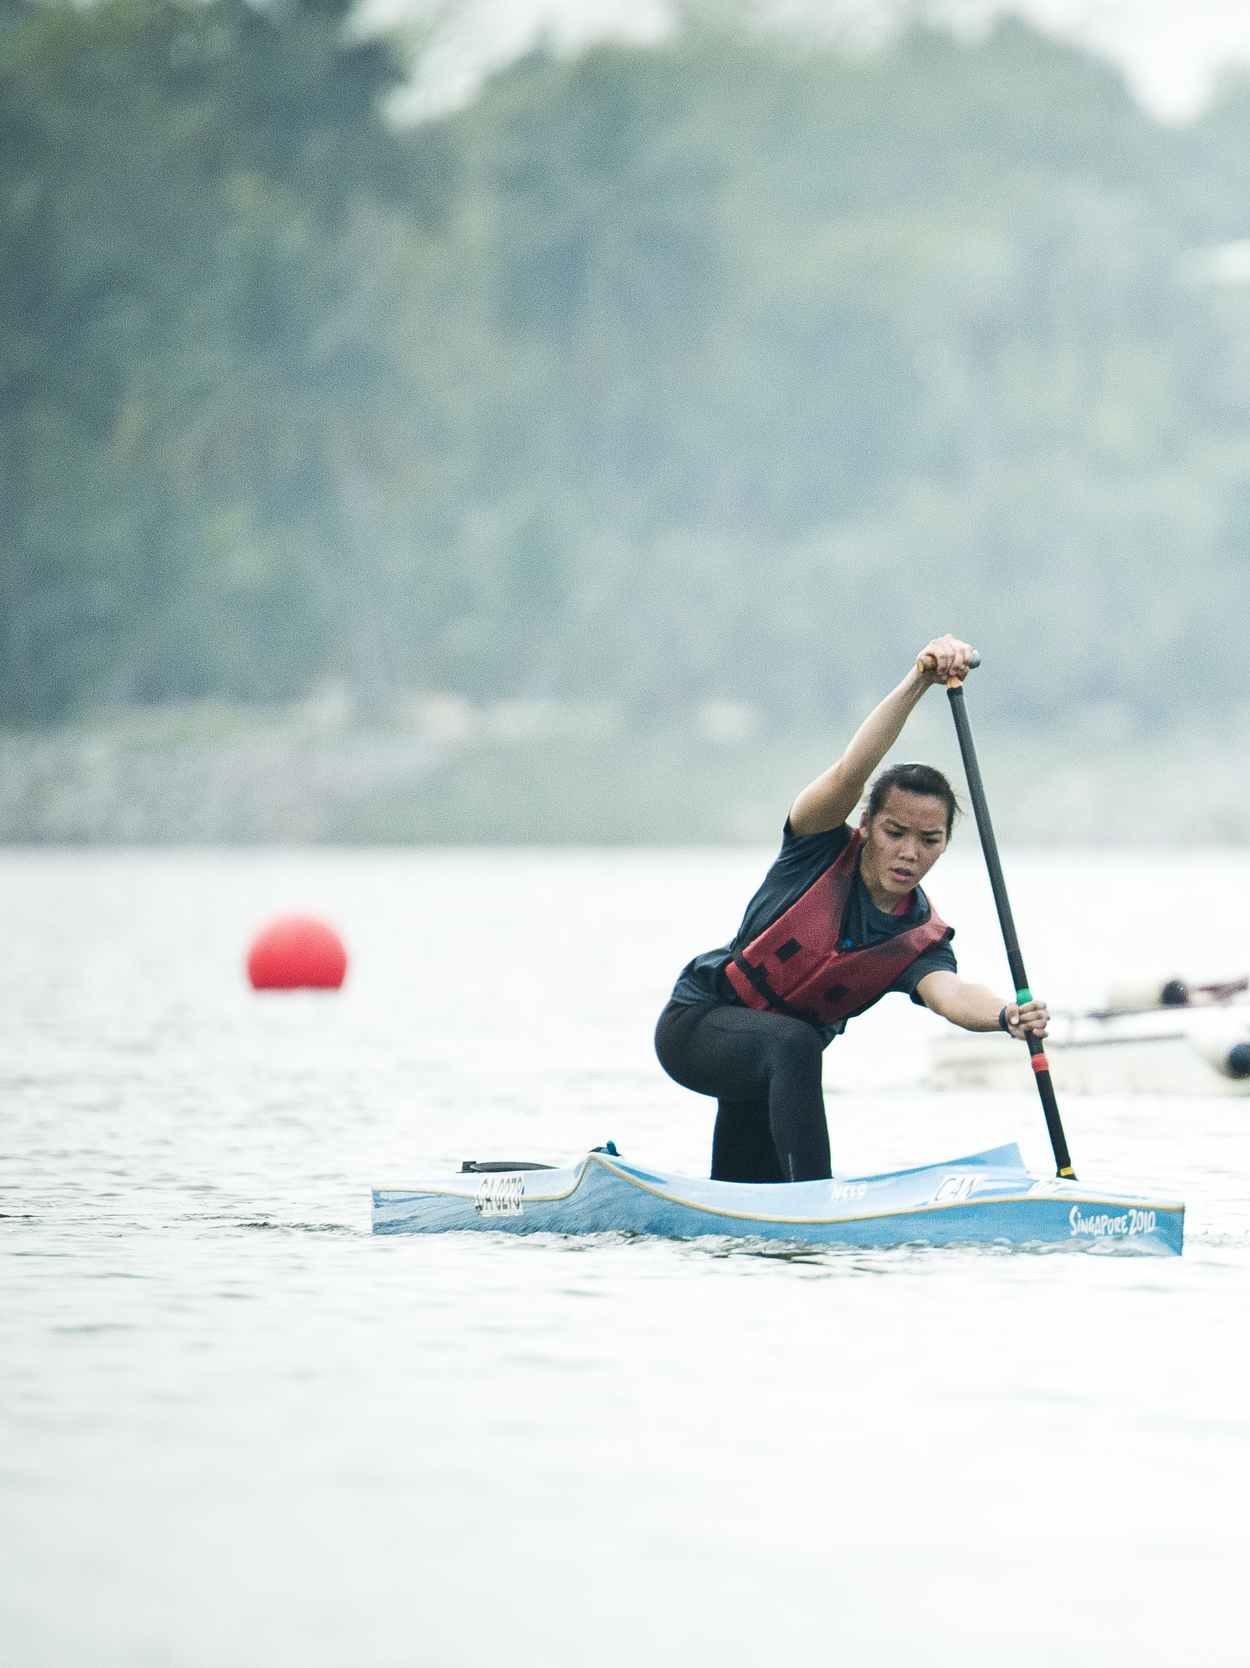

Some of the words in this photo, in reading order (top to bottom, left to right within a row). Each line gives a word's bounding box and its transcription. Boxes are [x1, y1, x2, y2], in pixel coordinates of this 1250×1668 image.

[830, 1183, 867, 1199] NELO
[934, 1177, 984, 1201] CAN
[1128, 1208, 1156, 1235] 2010
